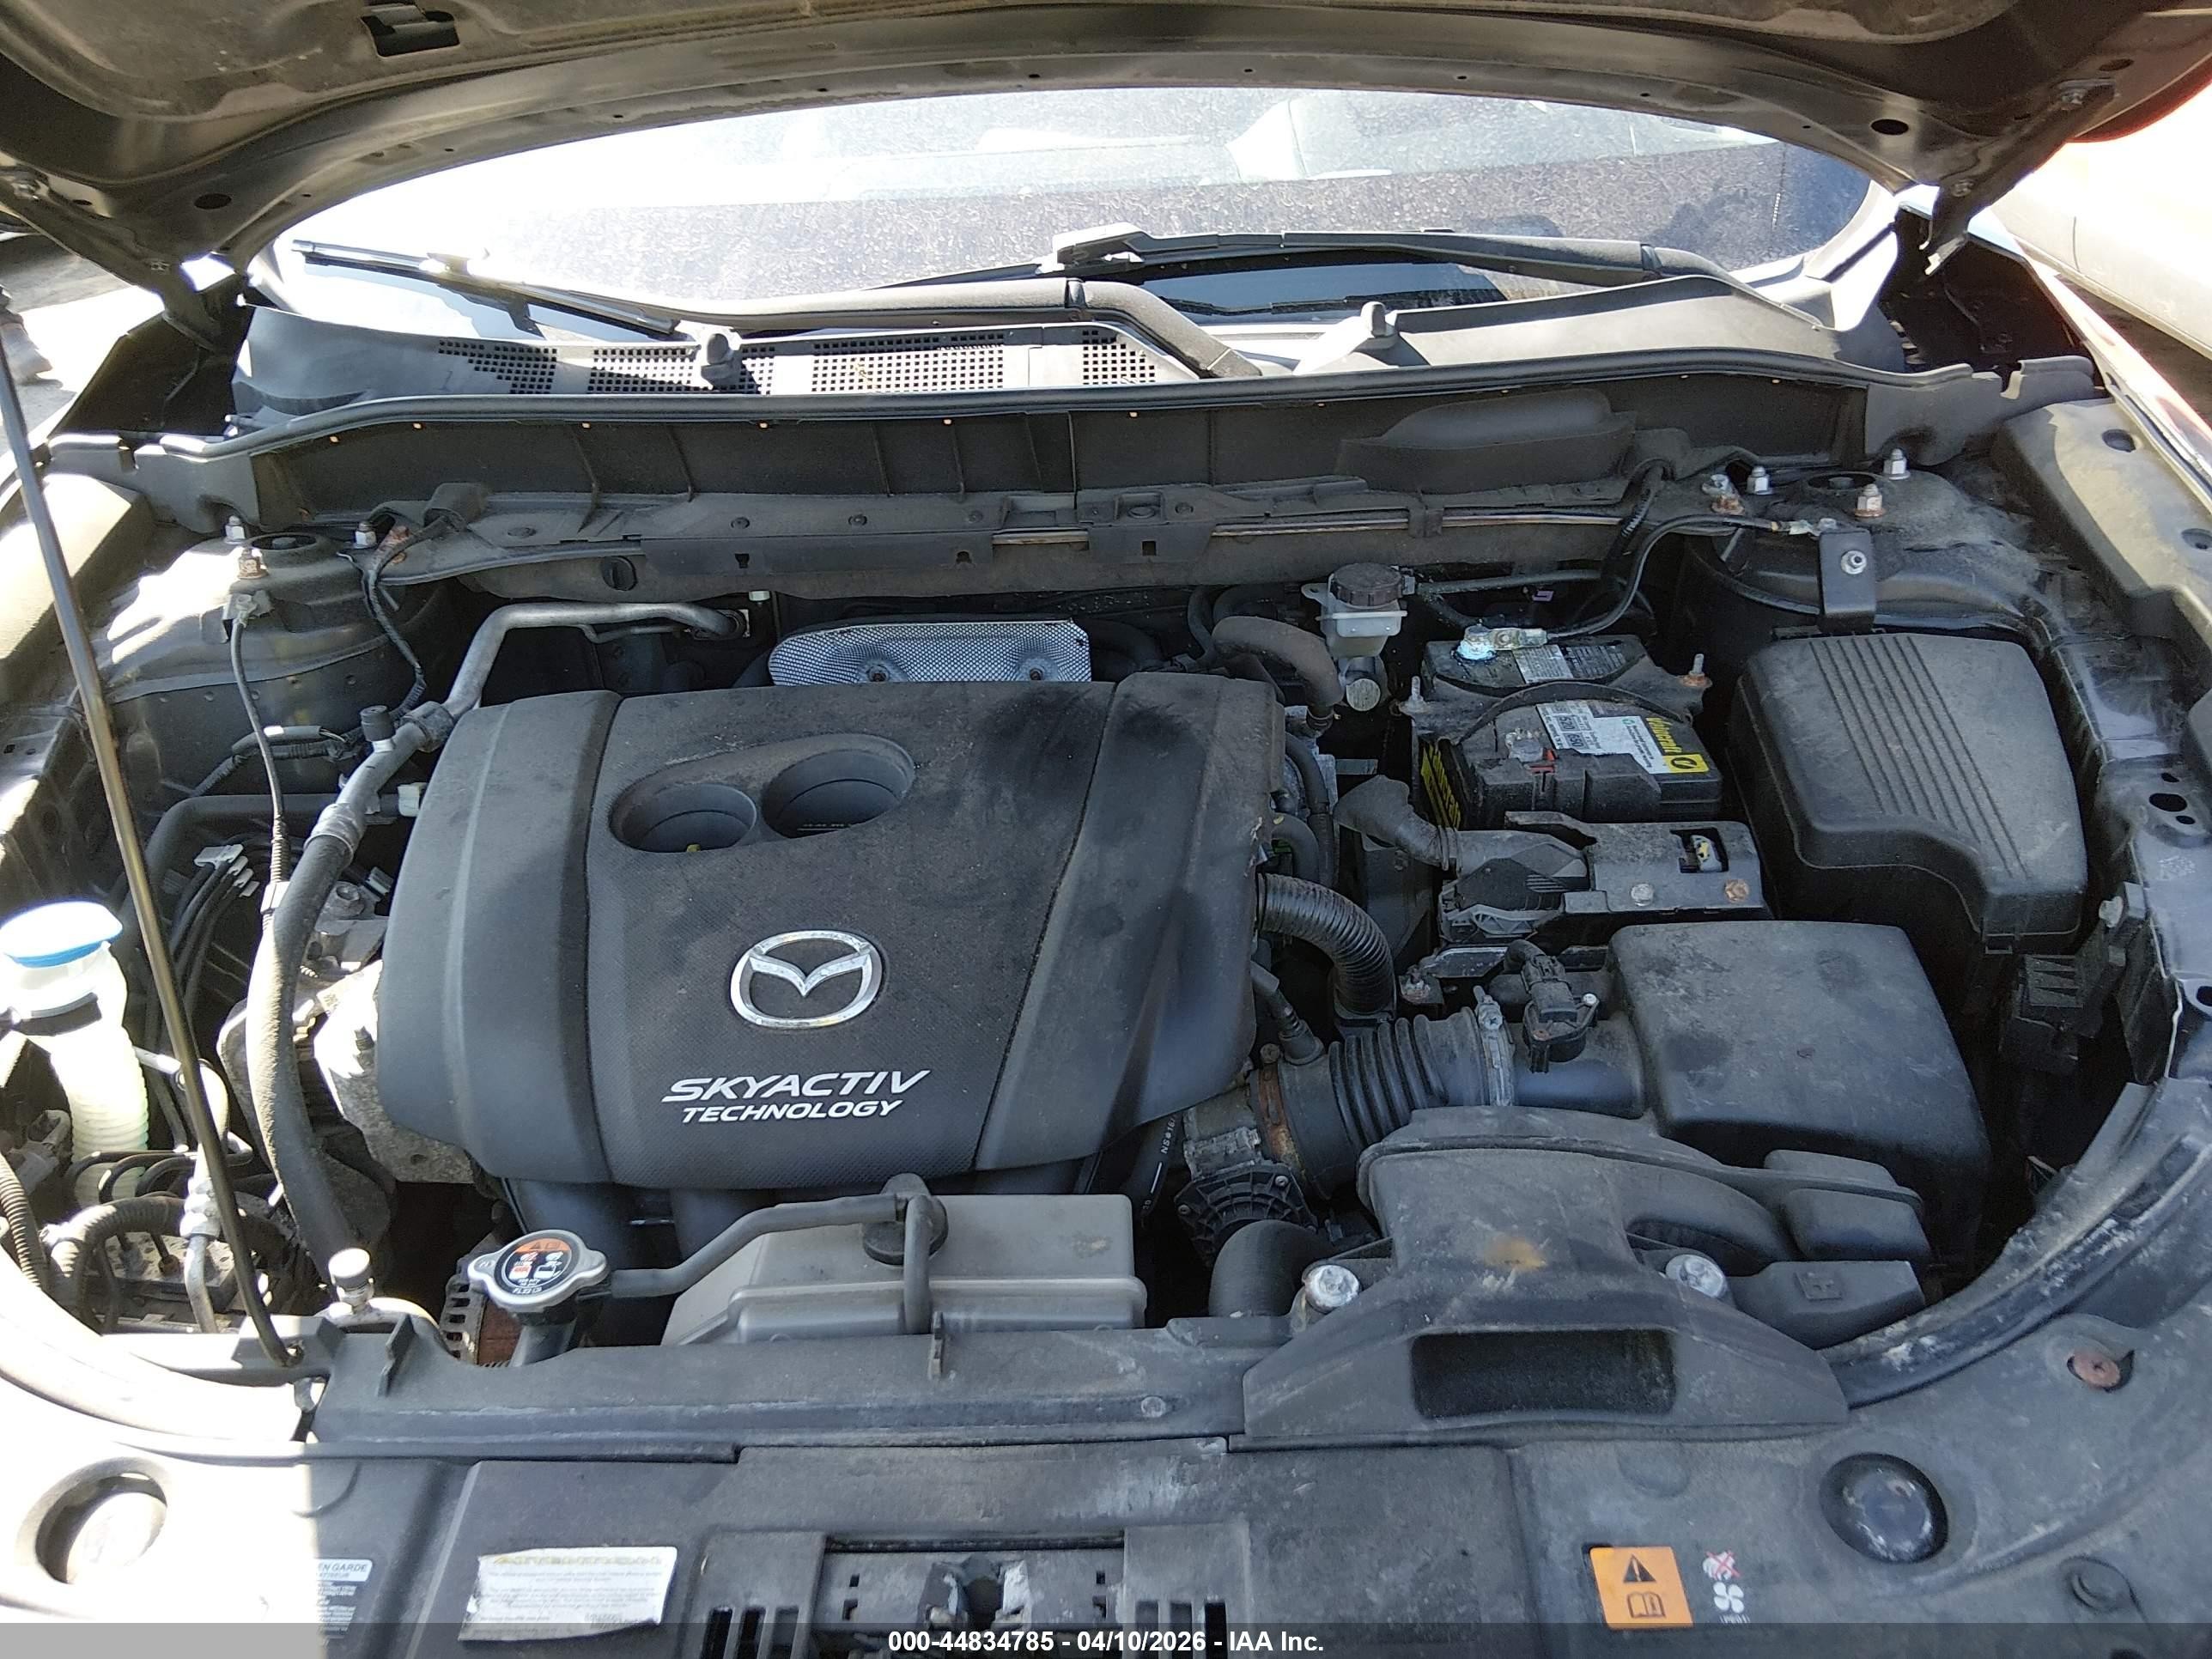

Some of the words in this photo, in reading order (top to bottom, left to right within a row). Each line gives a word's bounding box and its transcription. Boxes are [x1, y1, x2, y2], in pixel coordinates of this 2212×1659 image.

[1559, 716, 1576, 730] 520
[1566, 733, 1584, 747] 650
[1645, 717, 1682, 753] Valucraft
[661, 1070, 931, 1103] SKYACTIV
[683, 1100, 902, 1123] TECHNOLOGY
[331, 1564, 368, 1573] GARDE
